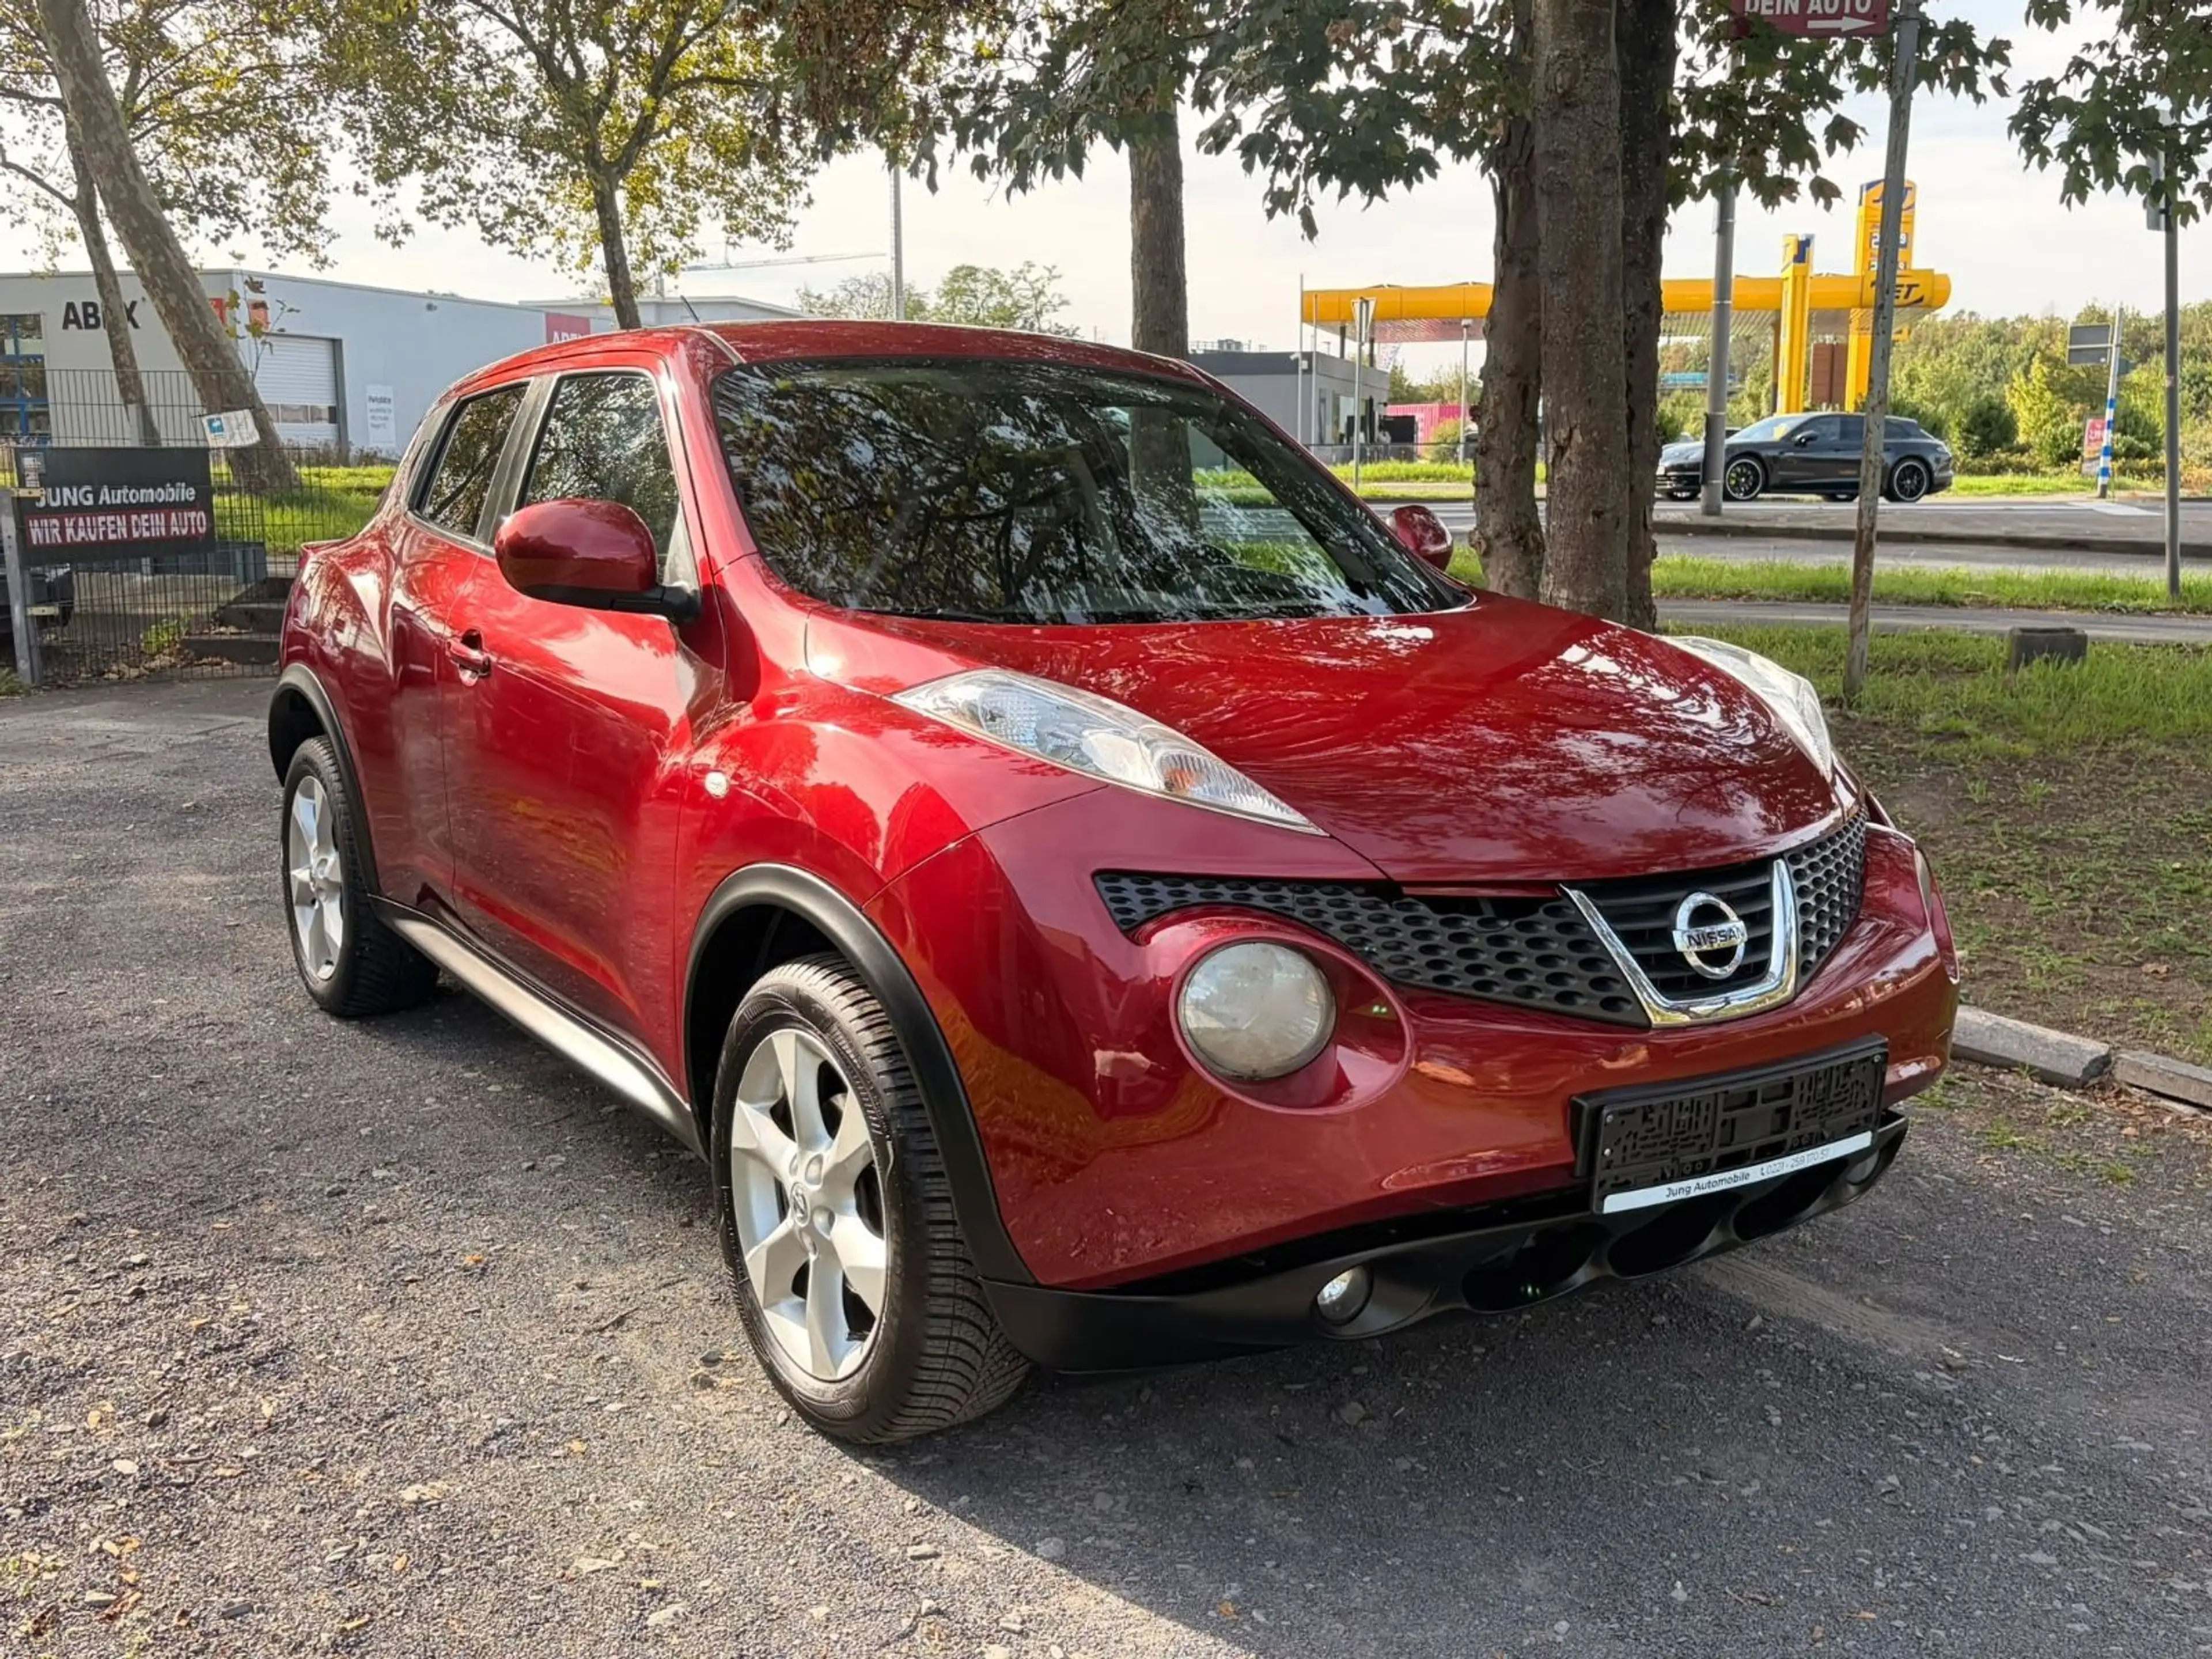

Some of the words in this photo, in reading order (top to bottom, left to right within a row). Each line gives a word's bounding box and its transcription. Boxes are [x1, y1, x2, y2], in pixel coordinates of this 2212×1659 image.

[1744, 0, 1800, 15] DEIN
[62, 300, 141, 330] ABX
[35, 485, 94, 507] JUNG
[99, 482, 196, 505] Automobile
[29, 516, 62, 545] WIR
[65, 514, 127, 543] KAUFEN
[131, 512, 166, 539] DEIN
[171, 510, 207, 536] AUTO
[1665, 1185, 1691, 1198] Jung
[1694, 1172, 1751, 1192] Automobile
